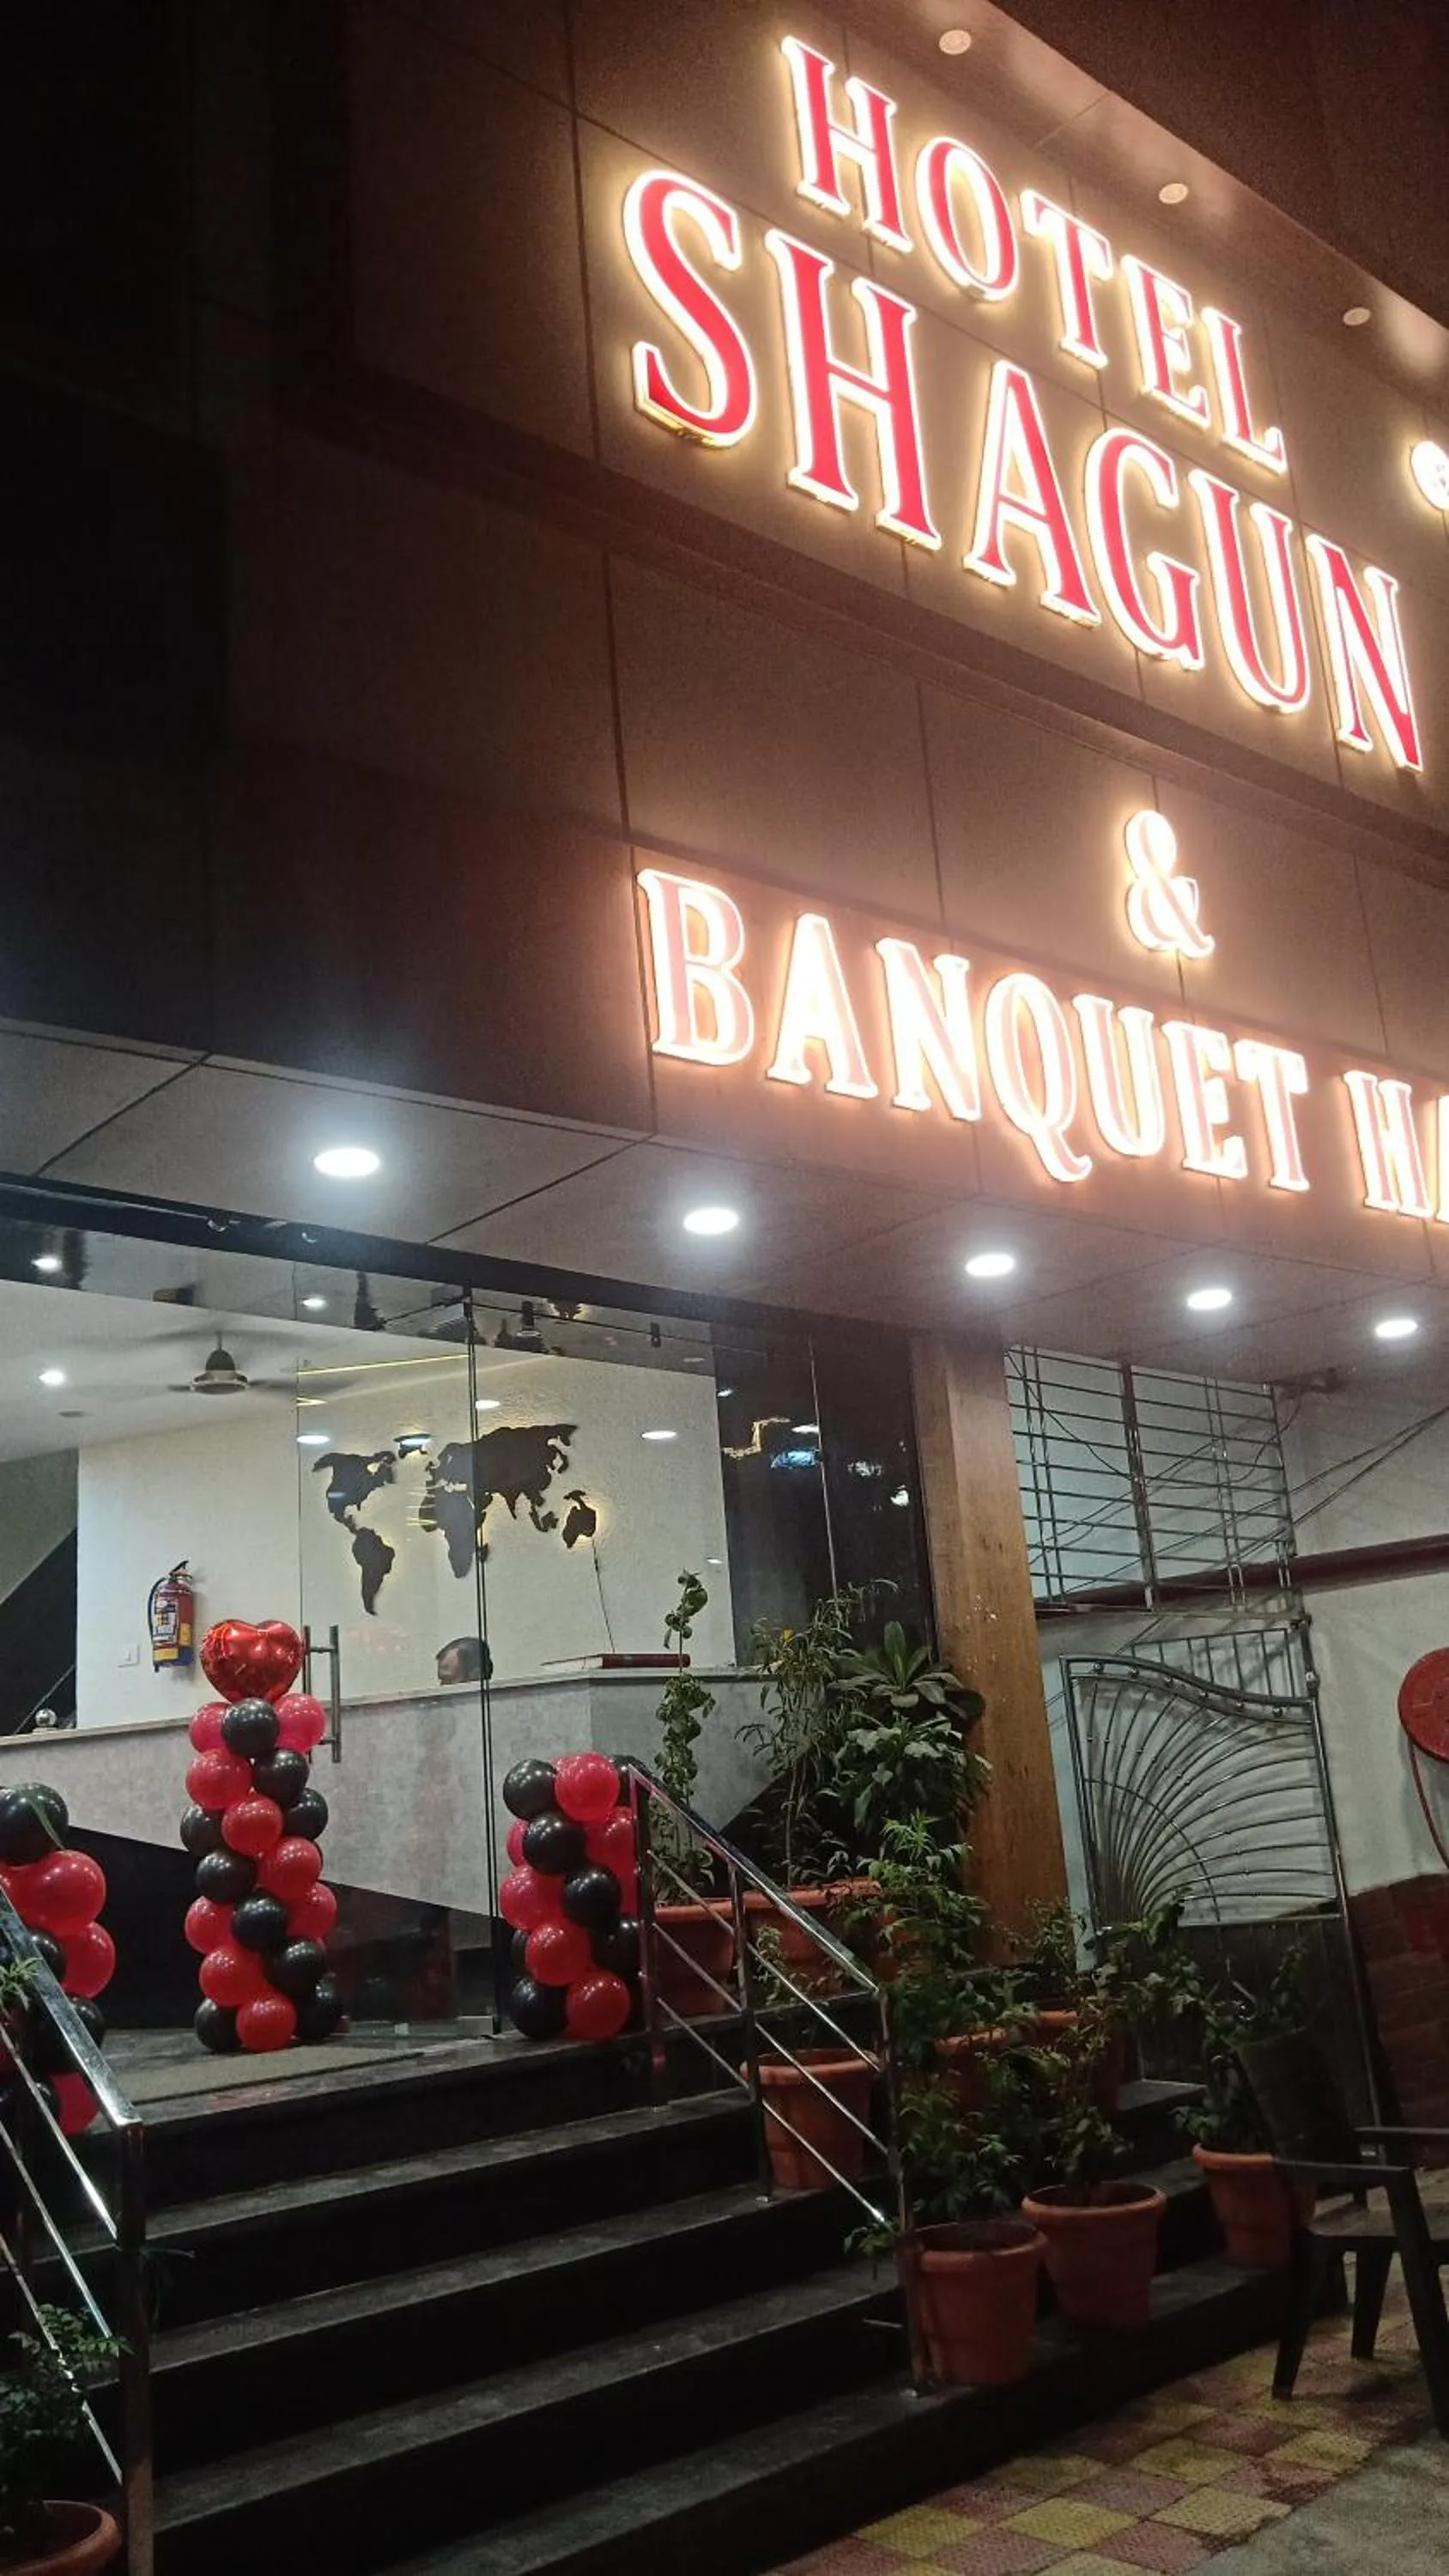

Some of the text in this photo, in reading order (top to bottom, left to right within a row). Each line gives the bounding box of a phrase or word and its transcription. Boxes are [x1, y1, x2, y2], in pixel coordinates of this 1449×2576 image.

[780, 35, 1287, 474] HOTEL
[622, 170, 1422, 771] SHAGUN
[636, 868, 1449, 1224] BANQUET H
[1123, 809, 1216, 959] &
